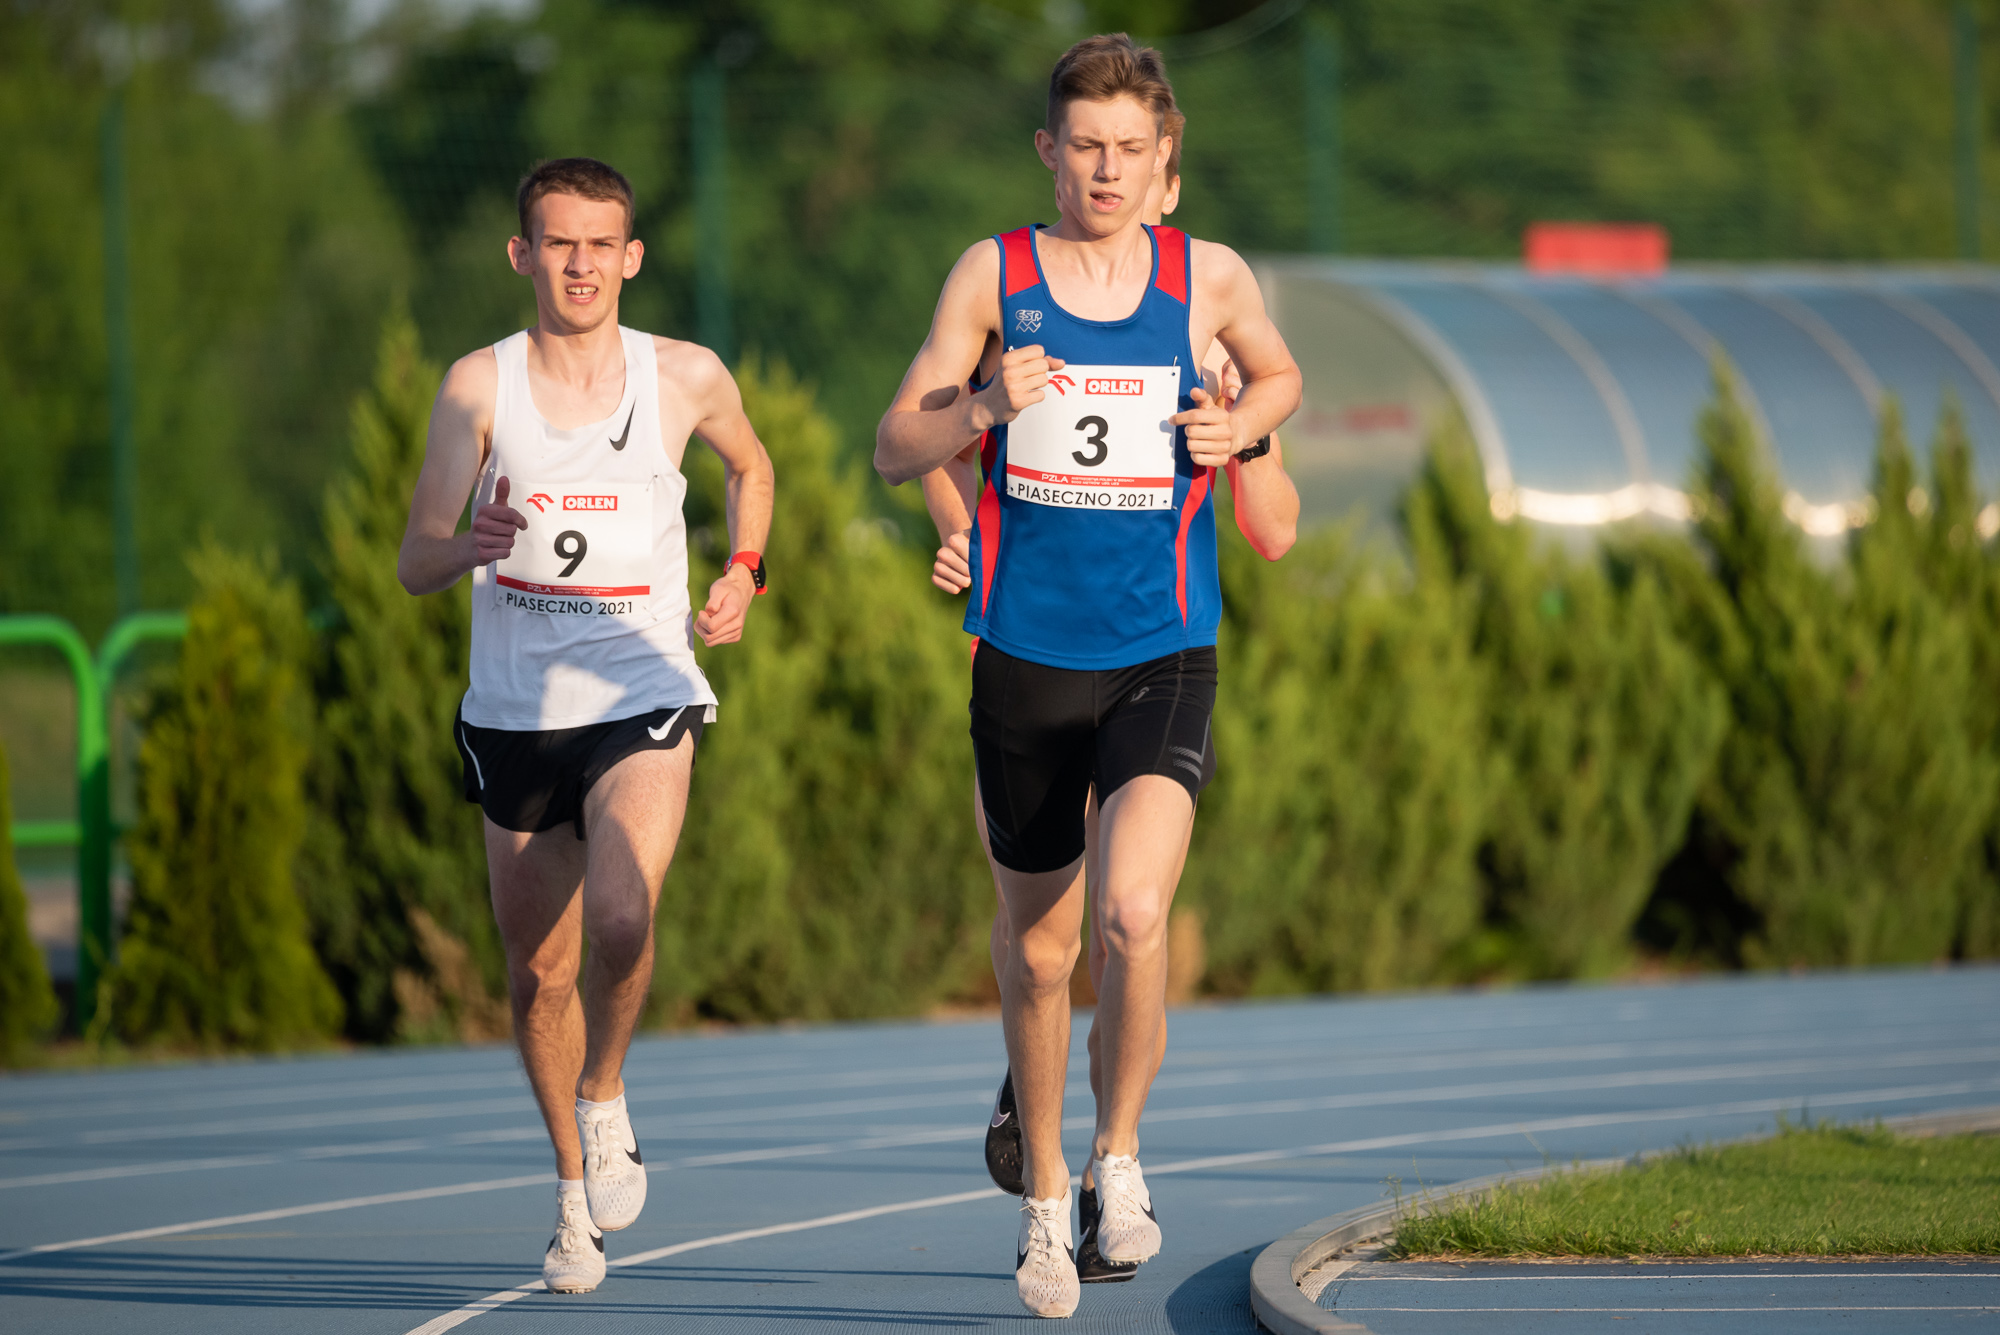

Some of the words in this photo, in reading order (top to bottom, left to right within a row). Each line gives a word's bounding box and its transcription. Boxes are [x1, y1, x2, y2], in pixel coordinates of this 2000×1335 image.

[1087, 380, 1141, 394] ORLEN
[1071, 415, 1109, 467] 3
[1041, 473, 1069, 484] PZLA
[564, 496, 616, 510] ORLEN
[1017, 483, 1112, 507] PIASECZNO
[1117, 493, 1154, 507] 2021
[553, 529, 588, 578] 9
[527, 584, 552, 594] PZLA
[506, 592, 593, 615] PIASECZNO
[597, 601, 633, 615] 2021
